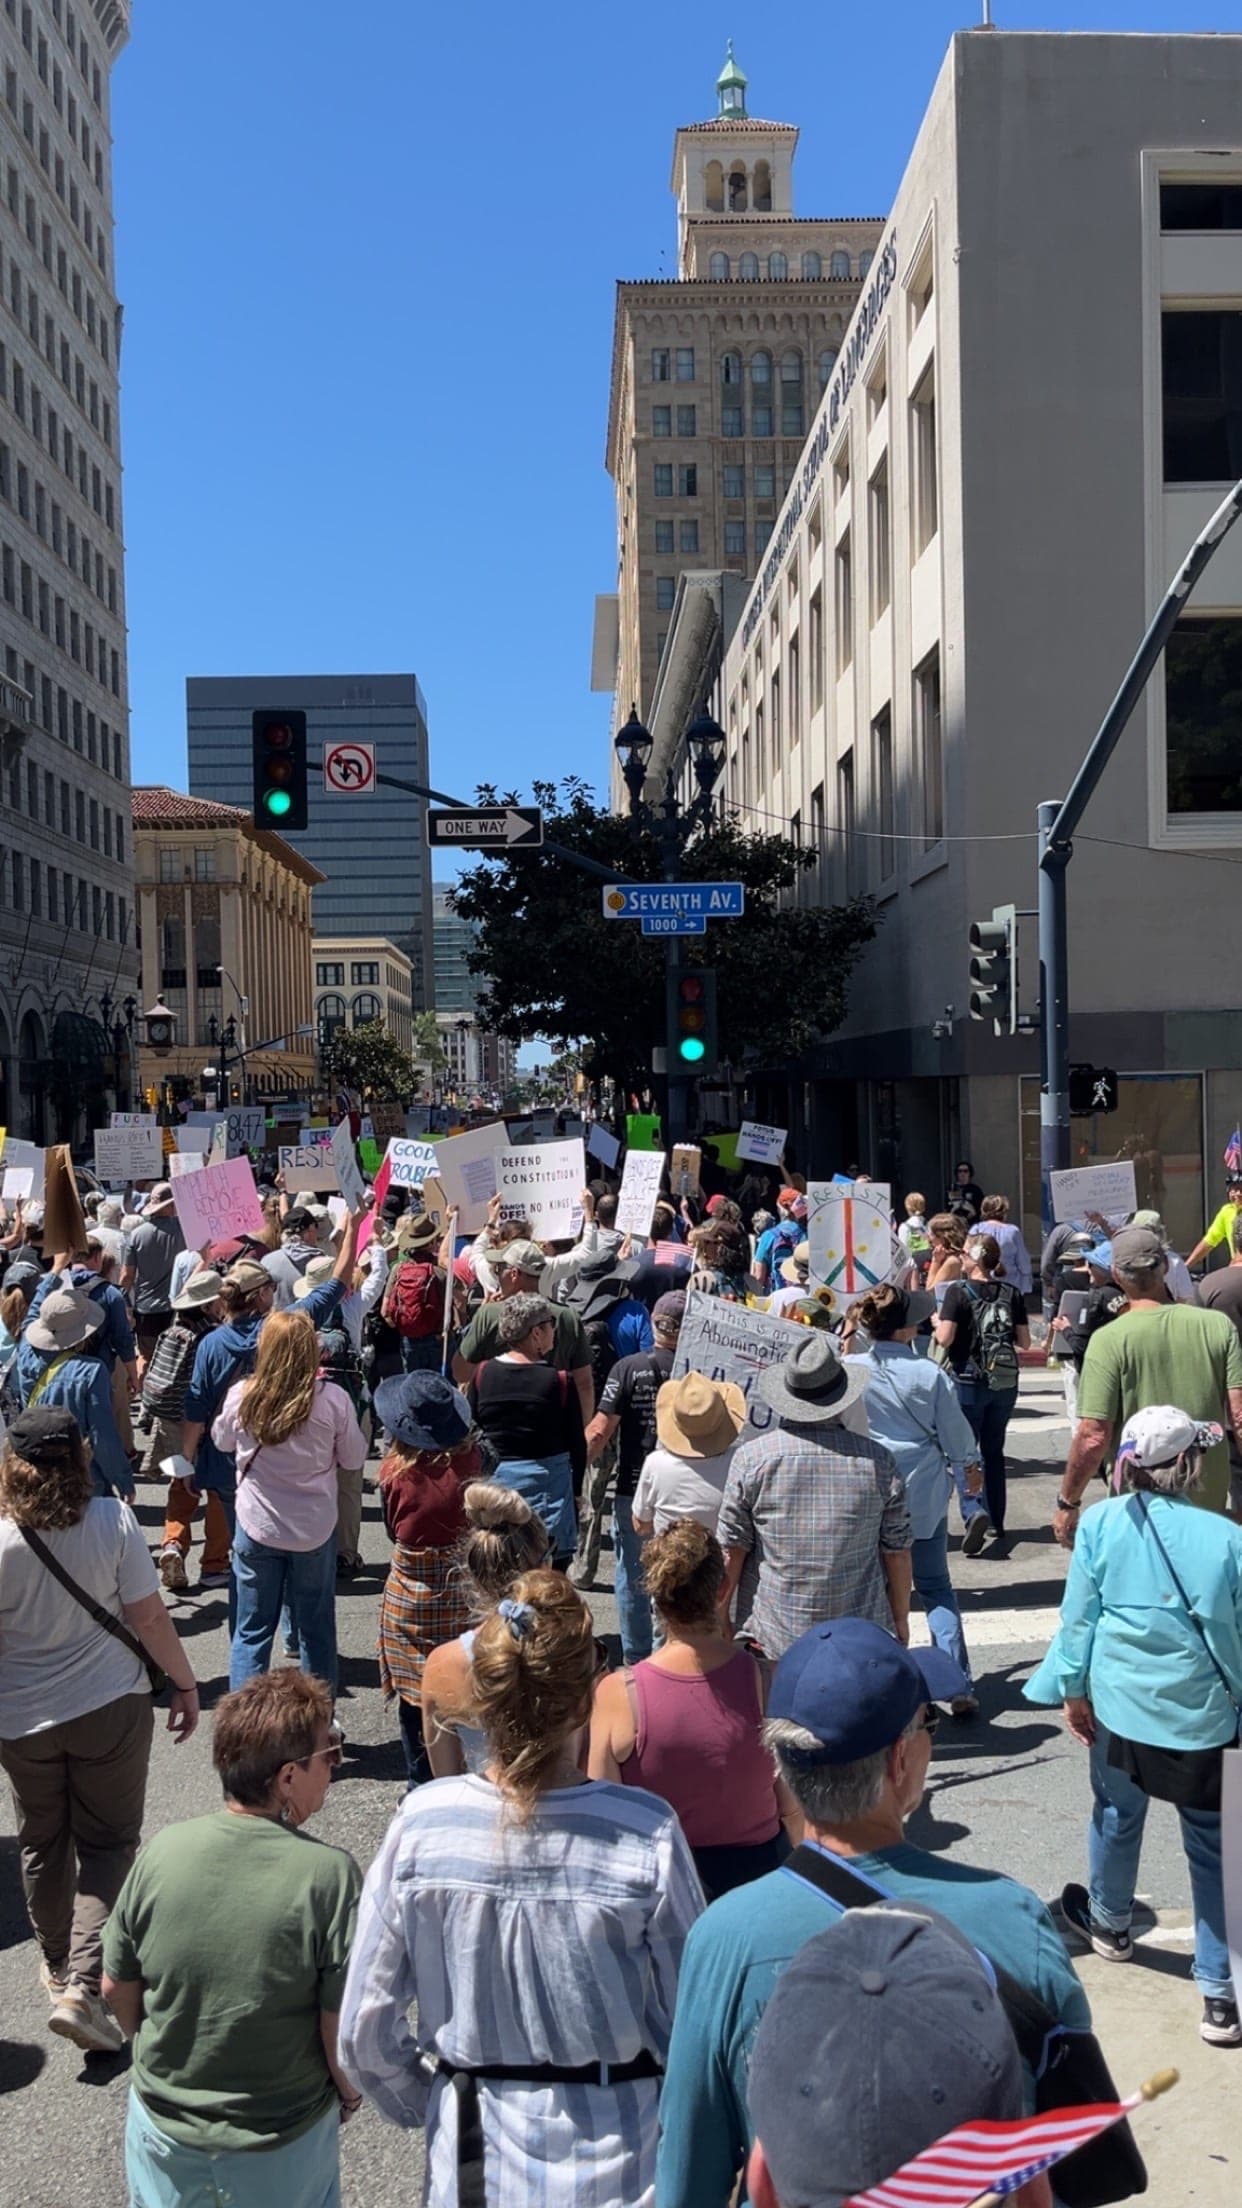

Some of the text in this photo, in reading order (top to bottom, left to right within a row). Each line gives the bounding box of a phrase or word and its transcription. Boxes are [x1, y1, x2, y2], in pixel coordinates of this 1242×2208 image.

[445, 820, 507, 834] ONE WAY
[629, 891, 701, 911] SEVENTH
[650, 919, 678, 931] 1000
[227, 1113, 261, 1141] 8647
[280, 1146, 337, 1169] RESIS
[393, 1141, 435, 1161] GOOD
[501, 1155, 542, 1168] DEFEND
[812, 1183, 889, 1209] RESIST
[500, 1210, 526, 1220] OFF!
[530, 1202, 542, 1213] NO
[720, 1307, 790, 1343] This is an
[701, 1319, 789, 1363] Abominatio
